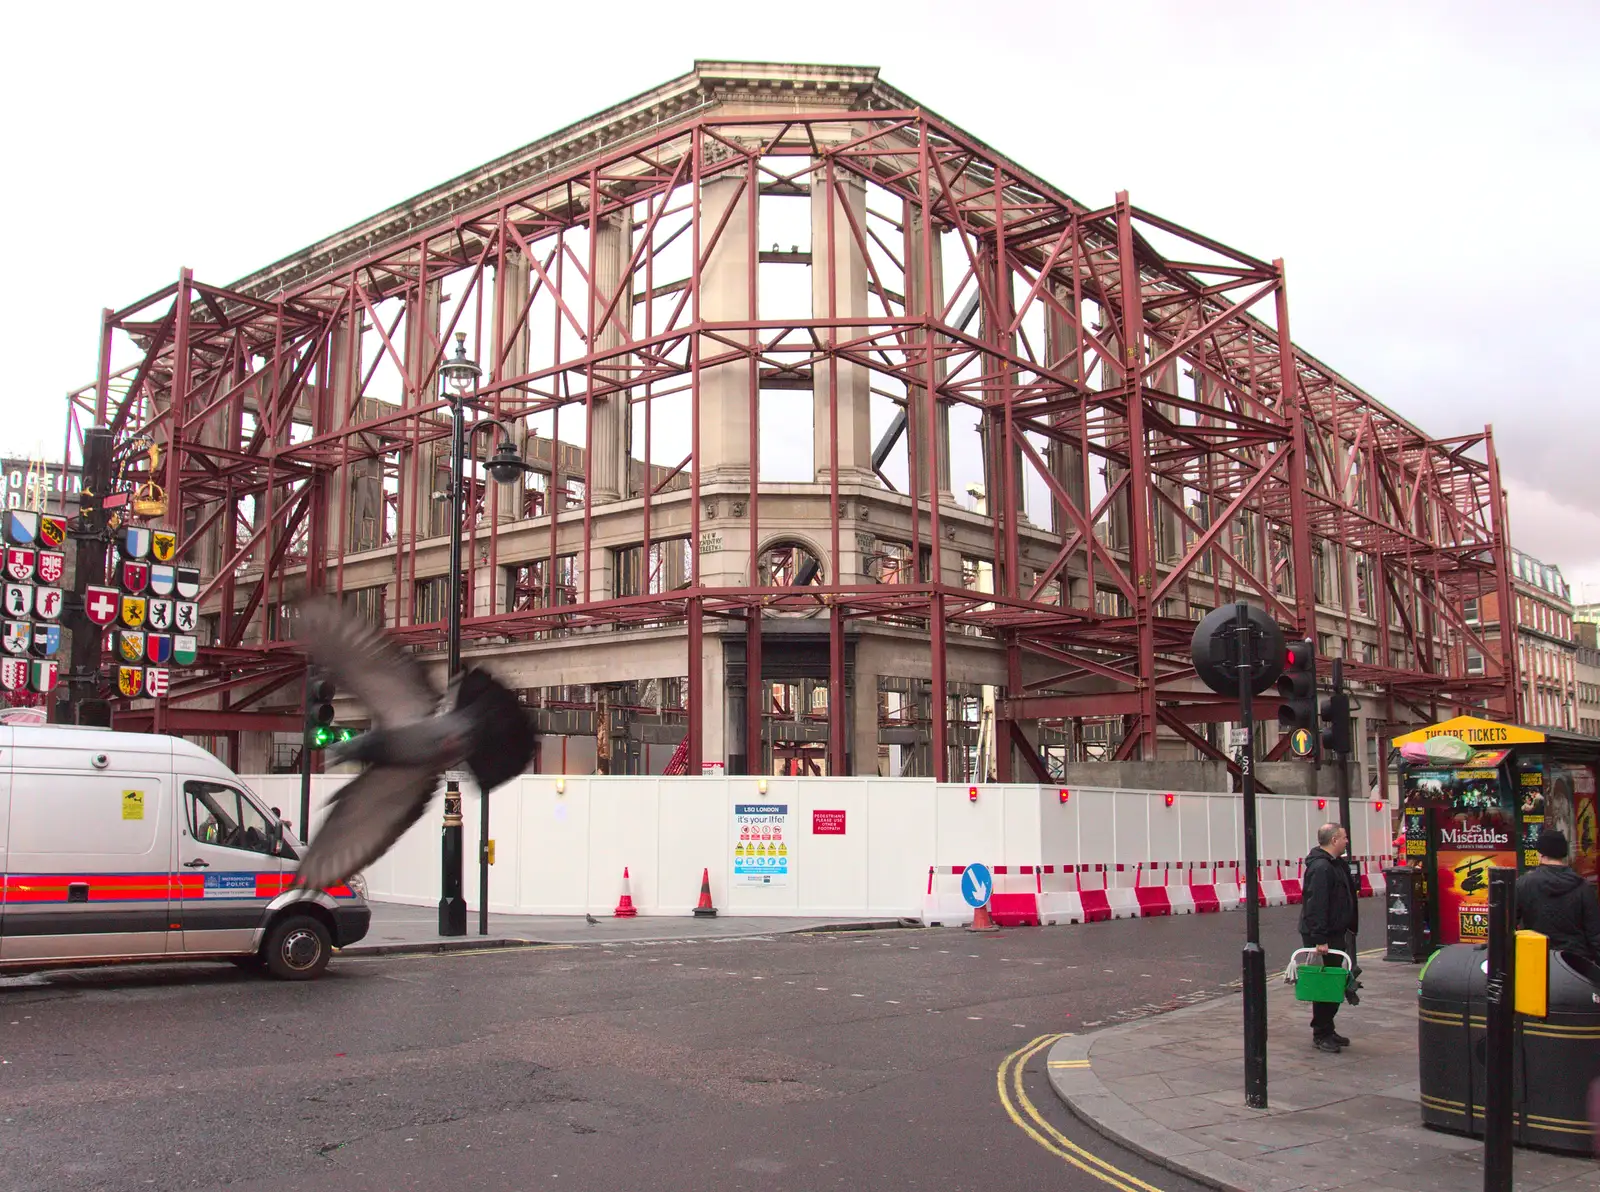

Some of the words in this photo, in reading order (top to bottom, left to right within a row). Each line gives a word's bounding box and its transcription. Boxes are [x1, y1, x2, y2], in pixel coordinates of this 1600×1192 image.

[699, 537, 722, 547] OVENTRY
[702, 532, 716, 540] NEW
[699, 545, 714, 553] TREET
[1468, 728, 1507, 742] TICKETS
[1463, 820, 1482, 833] Les
[1440, 828, 1509, 843] Misérables
[1463, 924, 1488, 936] Saigo
